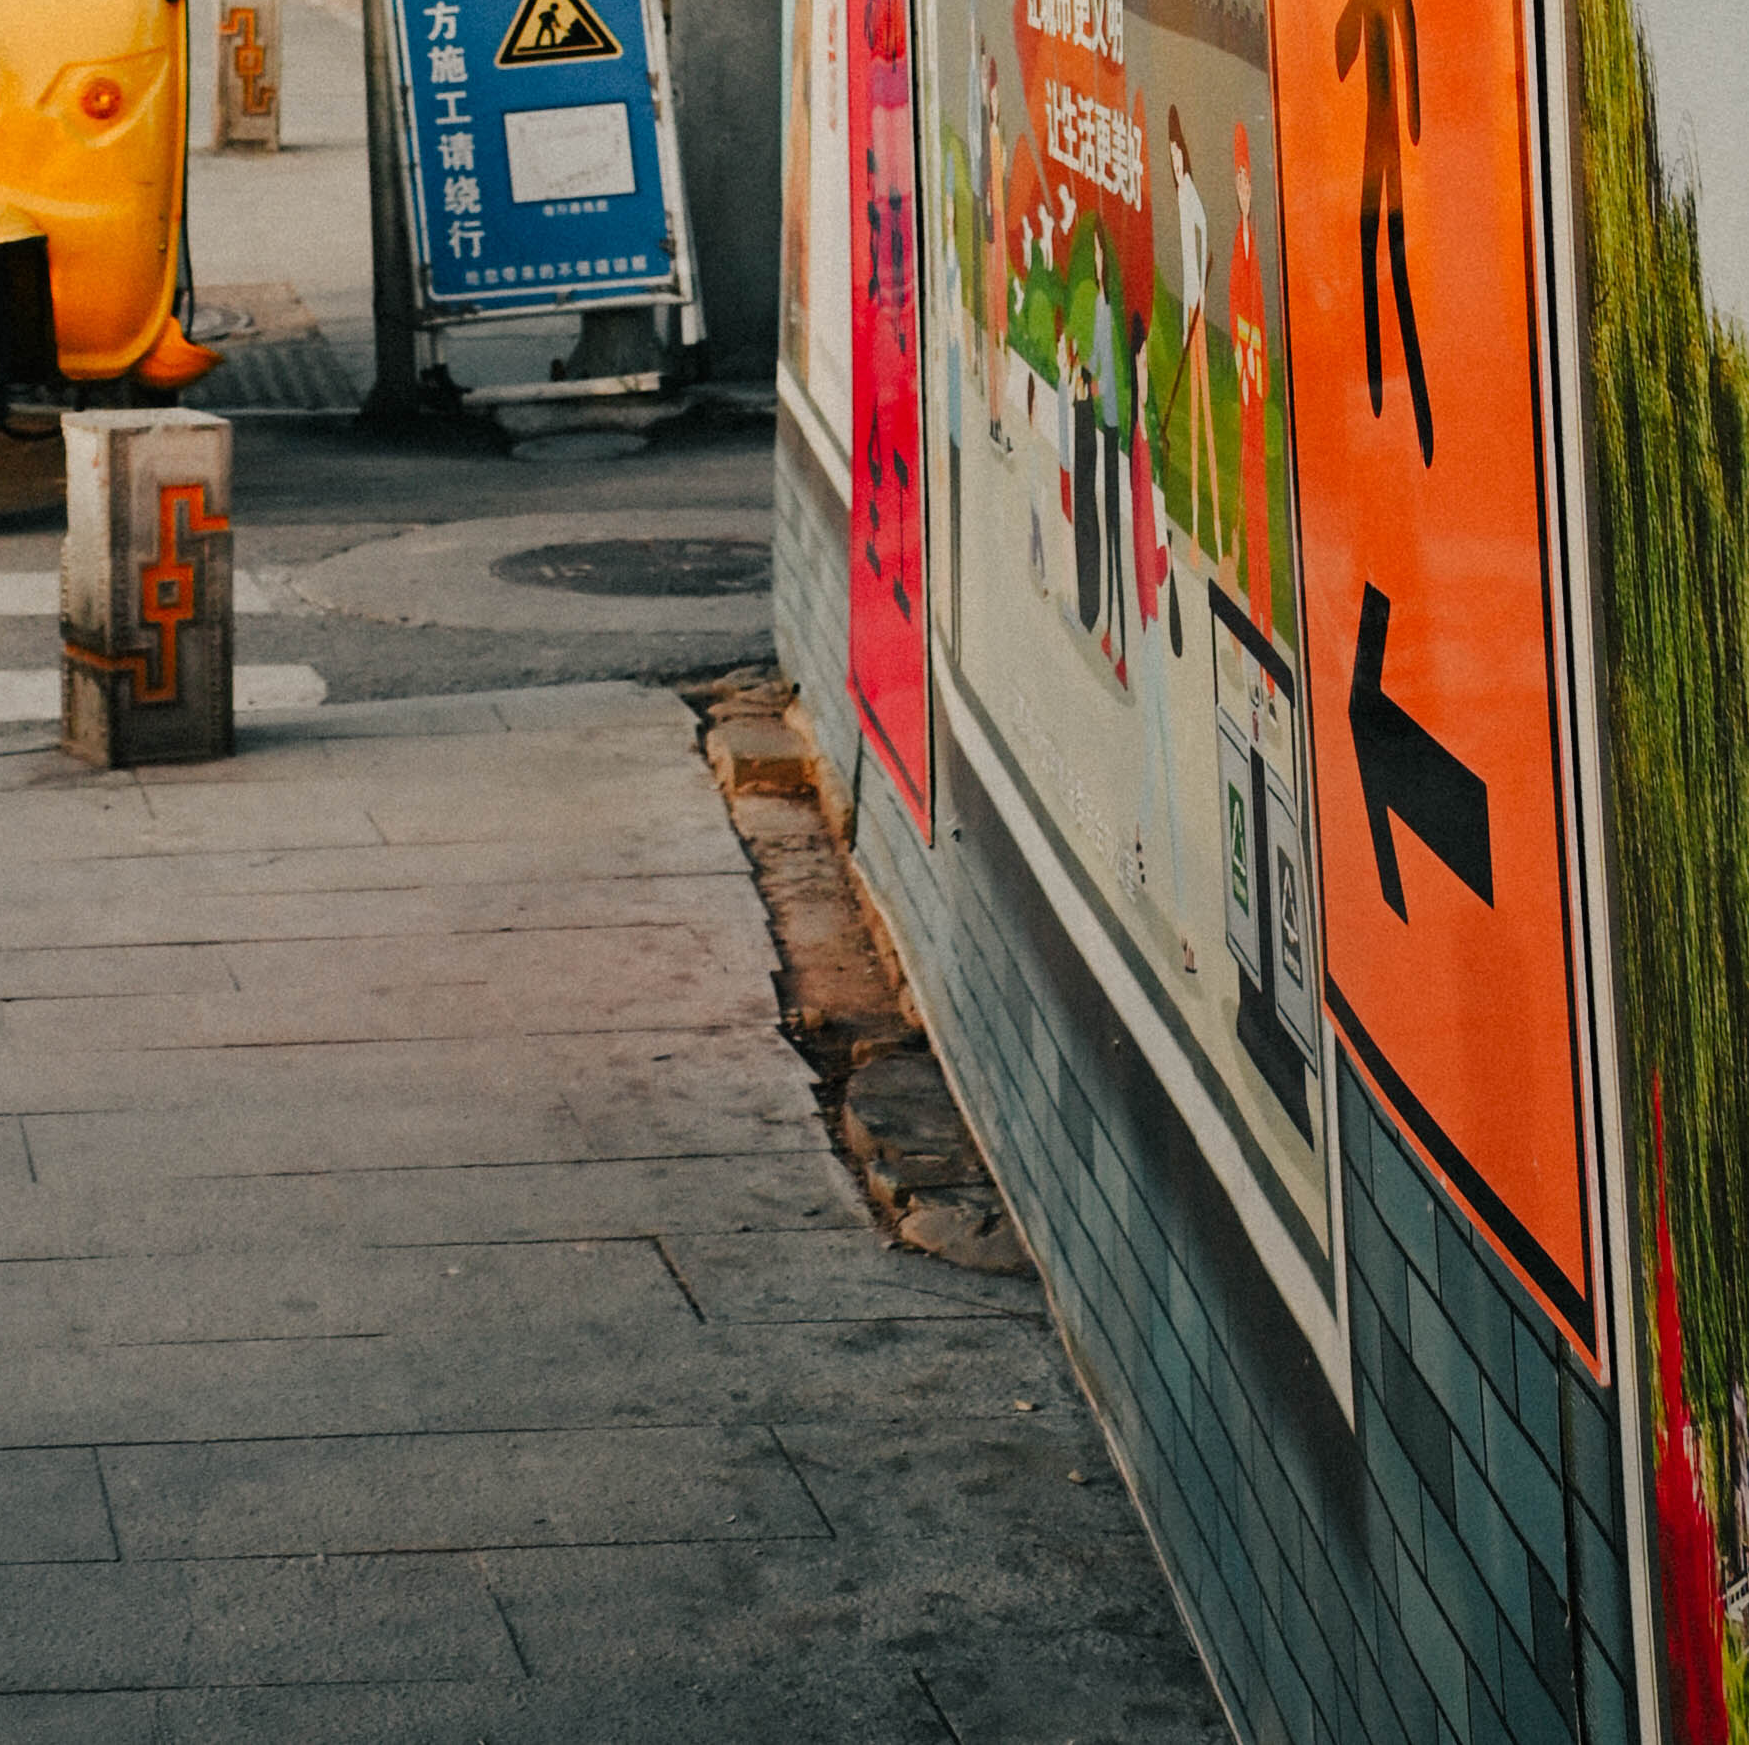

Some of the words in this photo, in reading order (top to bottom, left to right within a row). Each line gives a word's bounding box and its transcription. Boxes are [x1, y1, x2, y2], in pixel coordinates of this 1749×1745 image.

[1045, 77, 1144, 213] 让生活更美好
